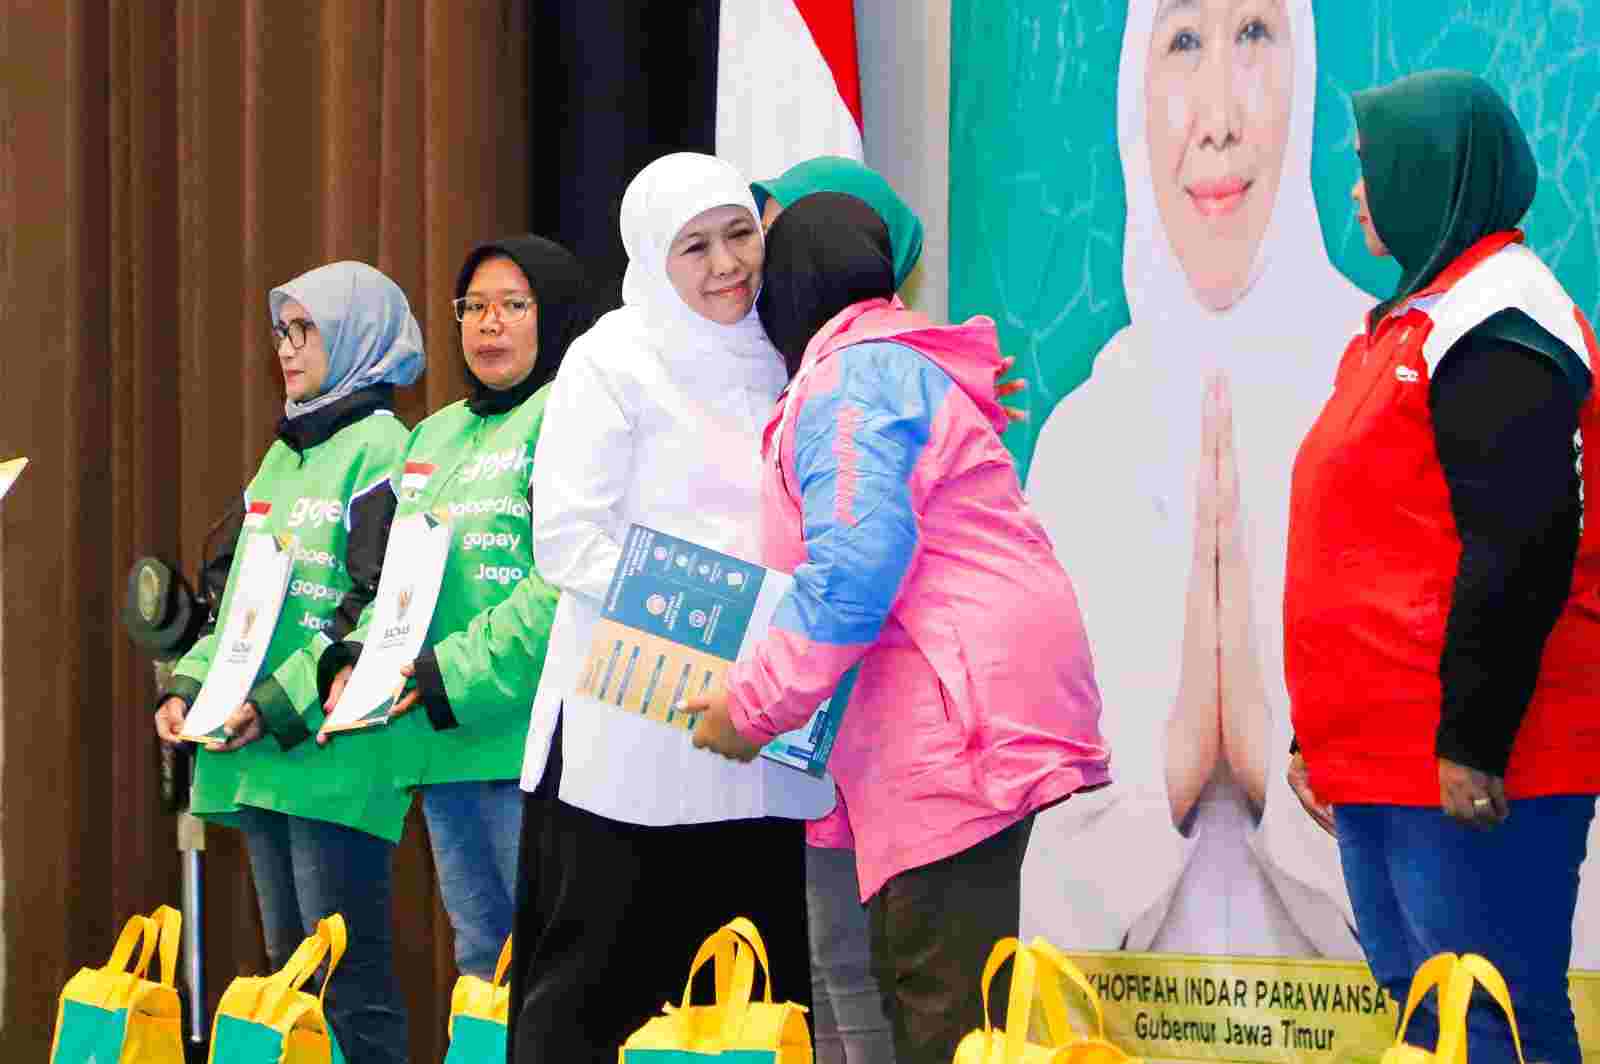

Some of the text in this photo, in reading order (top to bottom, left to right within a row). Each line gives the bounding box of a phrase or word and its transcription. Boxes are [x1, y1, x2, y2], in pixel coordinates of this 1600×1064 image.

[464, 532, 520, 551] gopay
[474, 564, 522, 585] Jago
[1184, 977, 1248, 1007] INDAR
[1255, 980, 1388, 1015] PARAWANSA
[1135, 1011, 1336, 1051] Gubernur Jawa Timur
